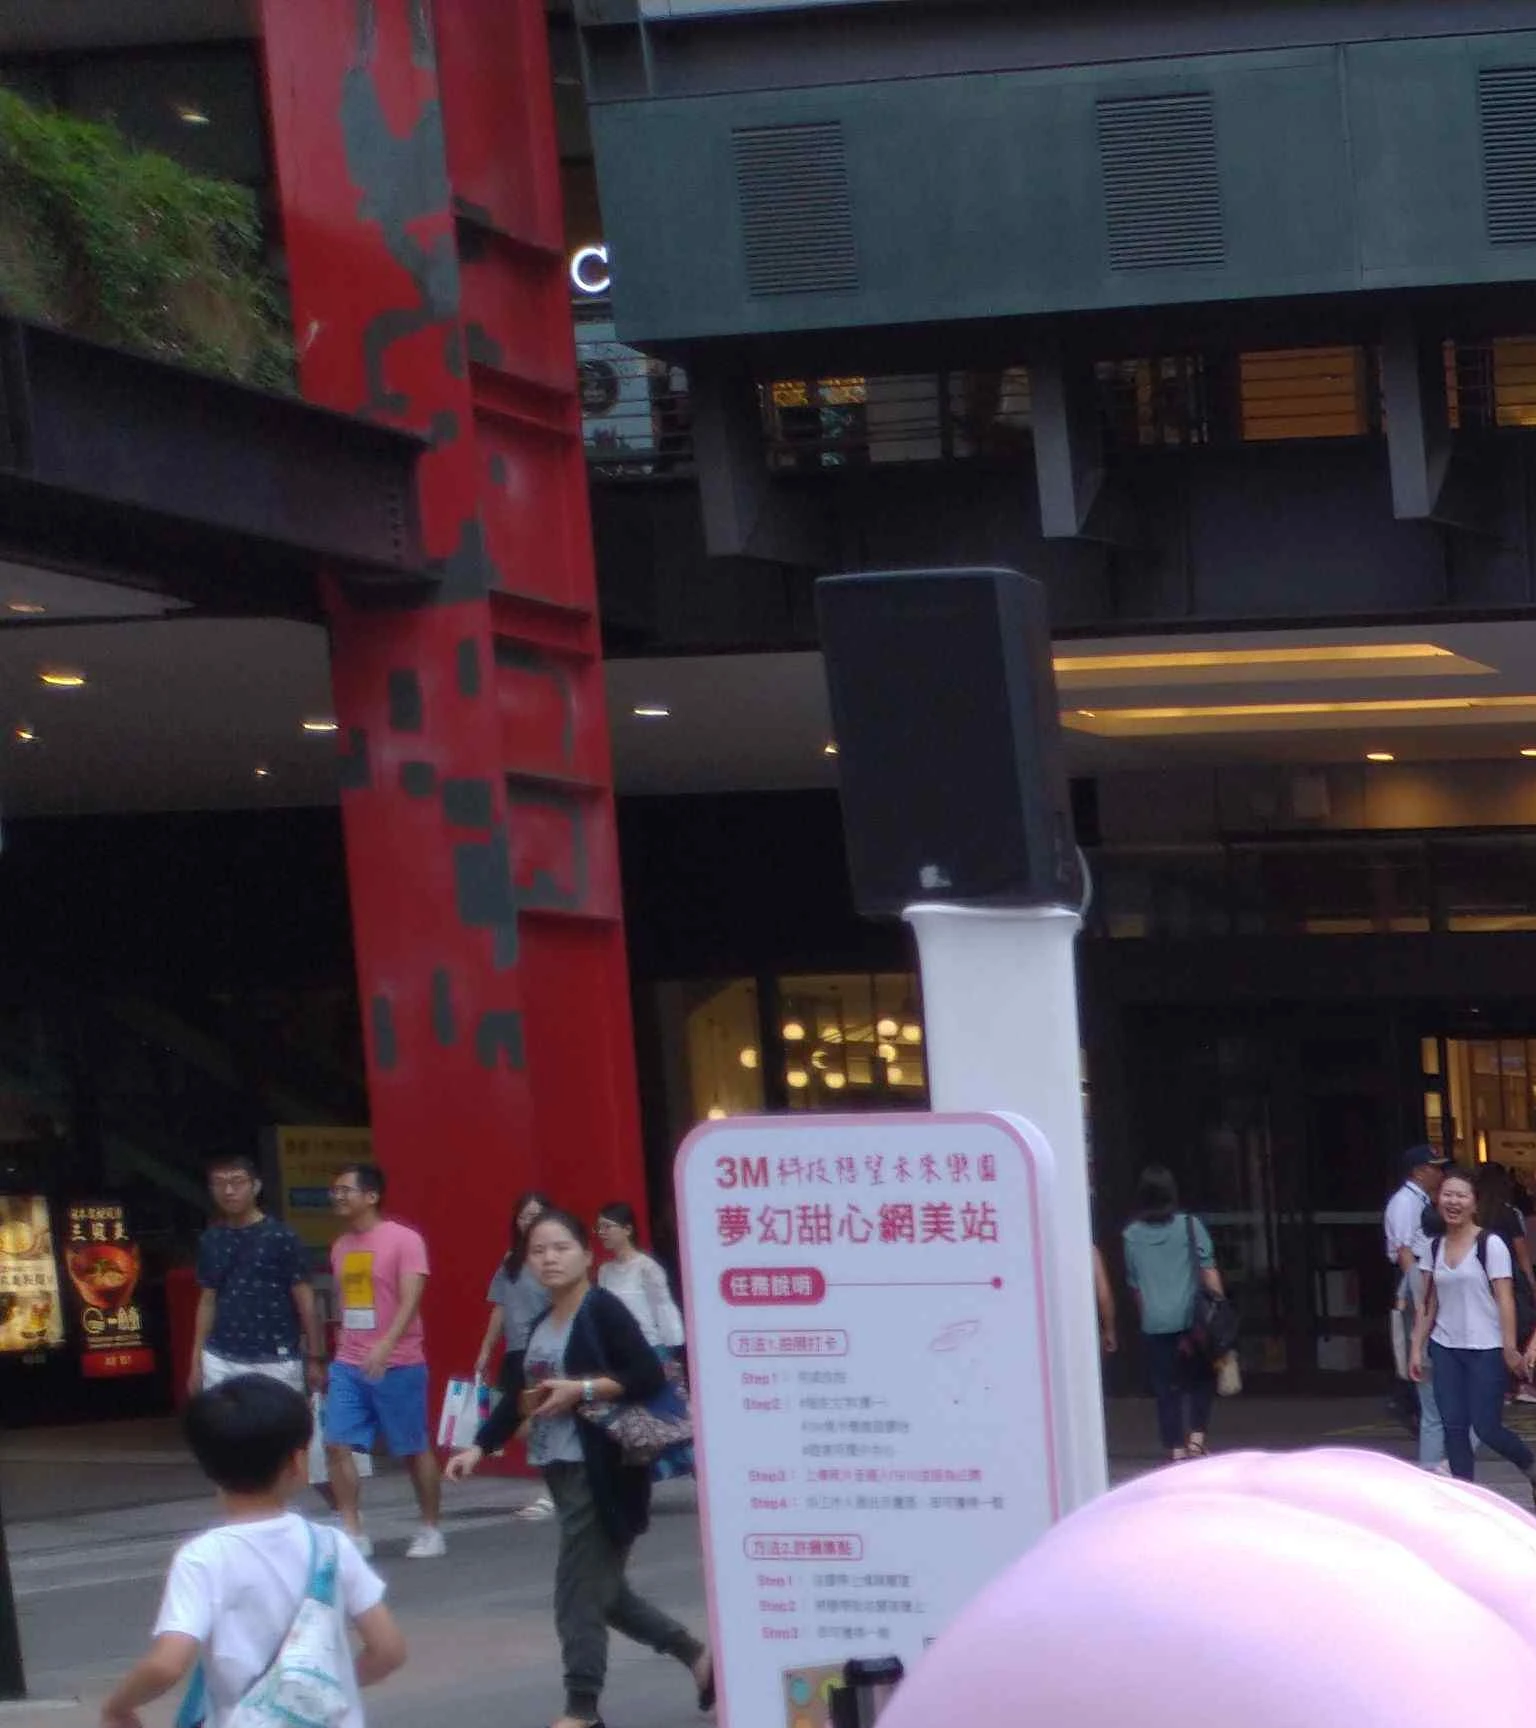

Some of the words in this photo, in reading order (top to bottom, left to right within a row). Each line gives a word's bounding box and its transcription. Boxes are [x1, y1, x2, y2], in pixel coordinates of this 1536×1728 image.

[715, 1155, 769, 1189] 3M
[715, 1201, 1000, 1246] 夢幻甜心網美站
